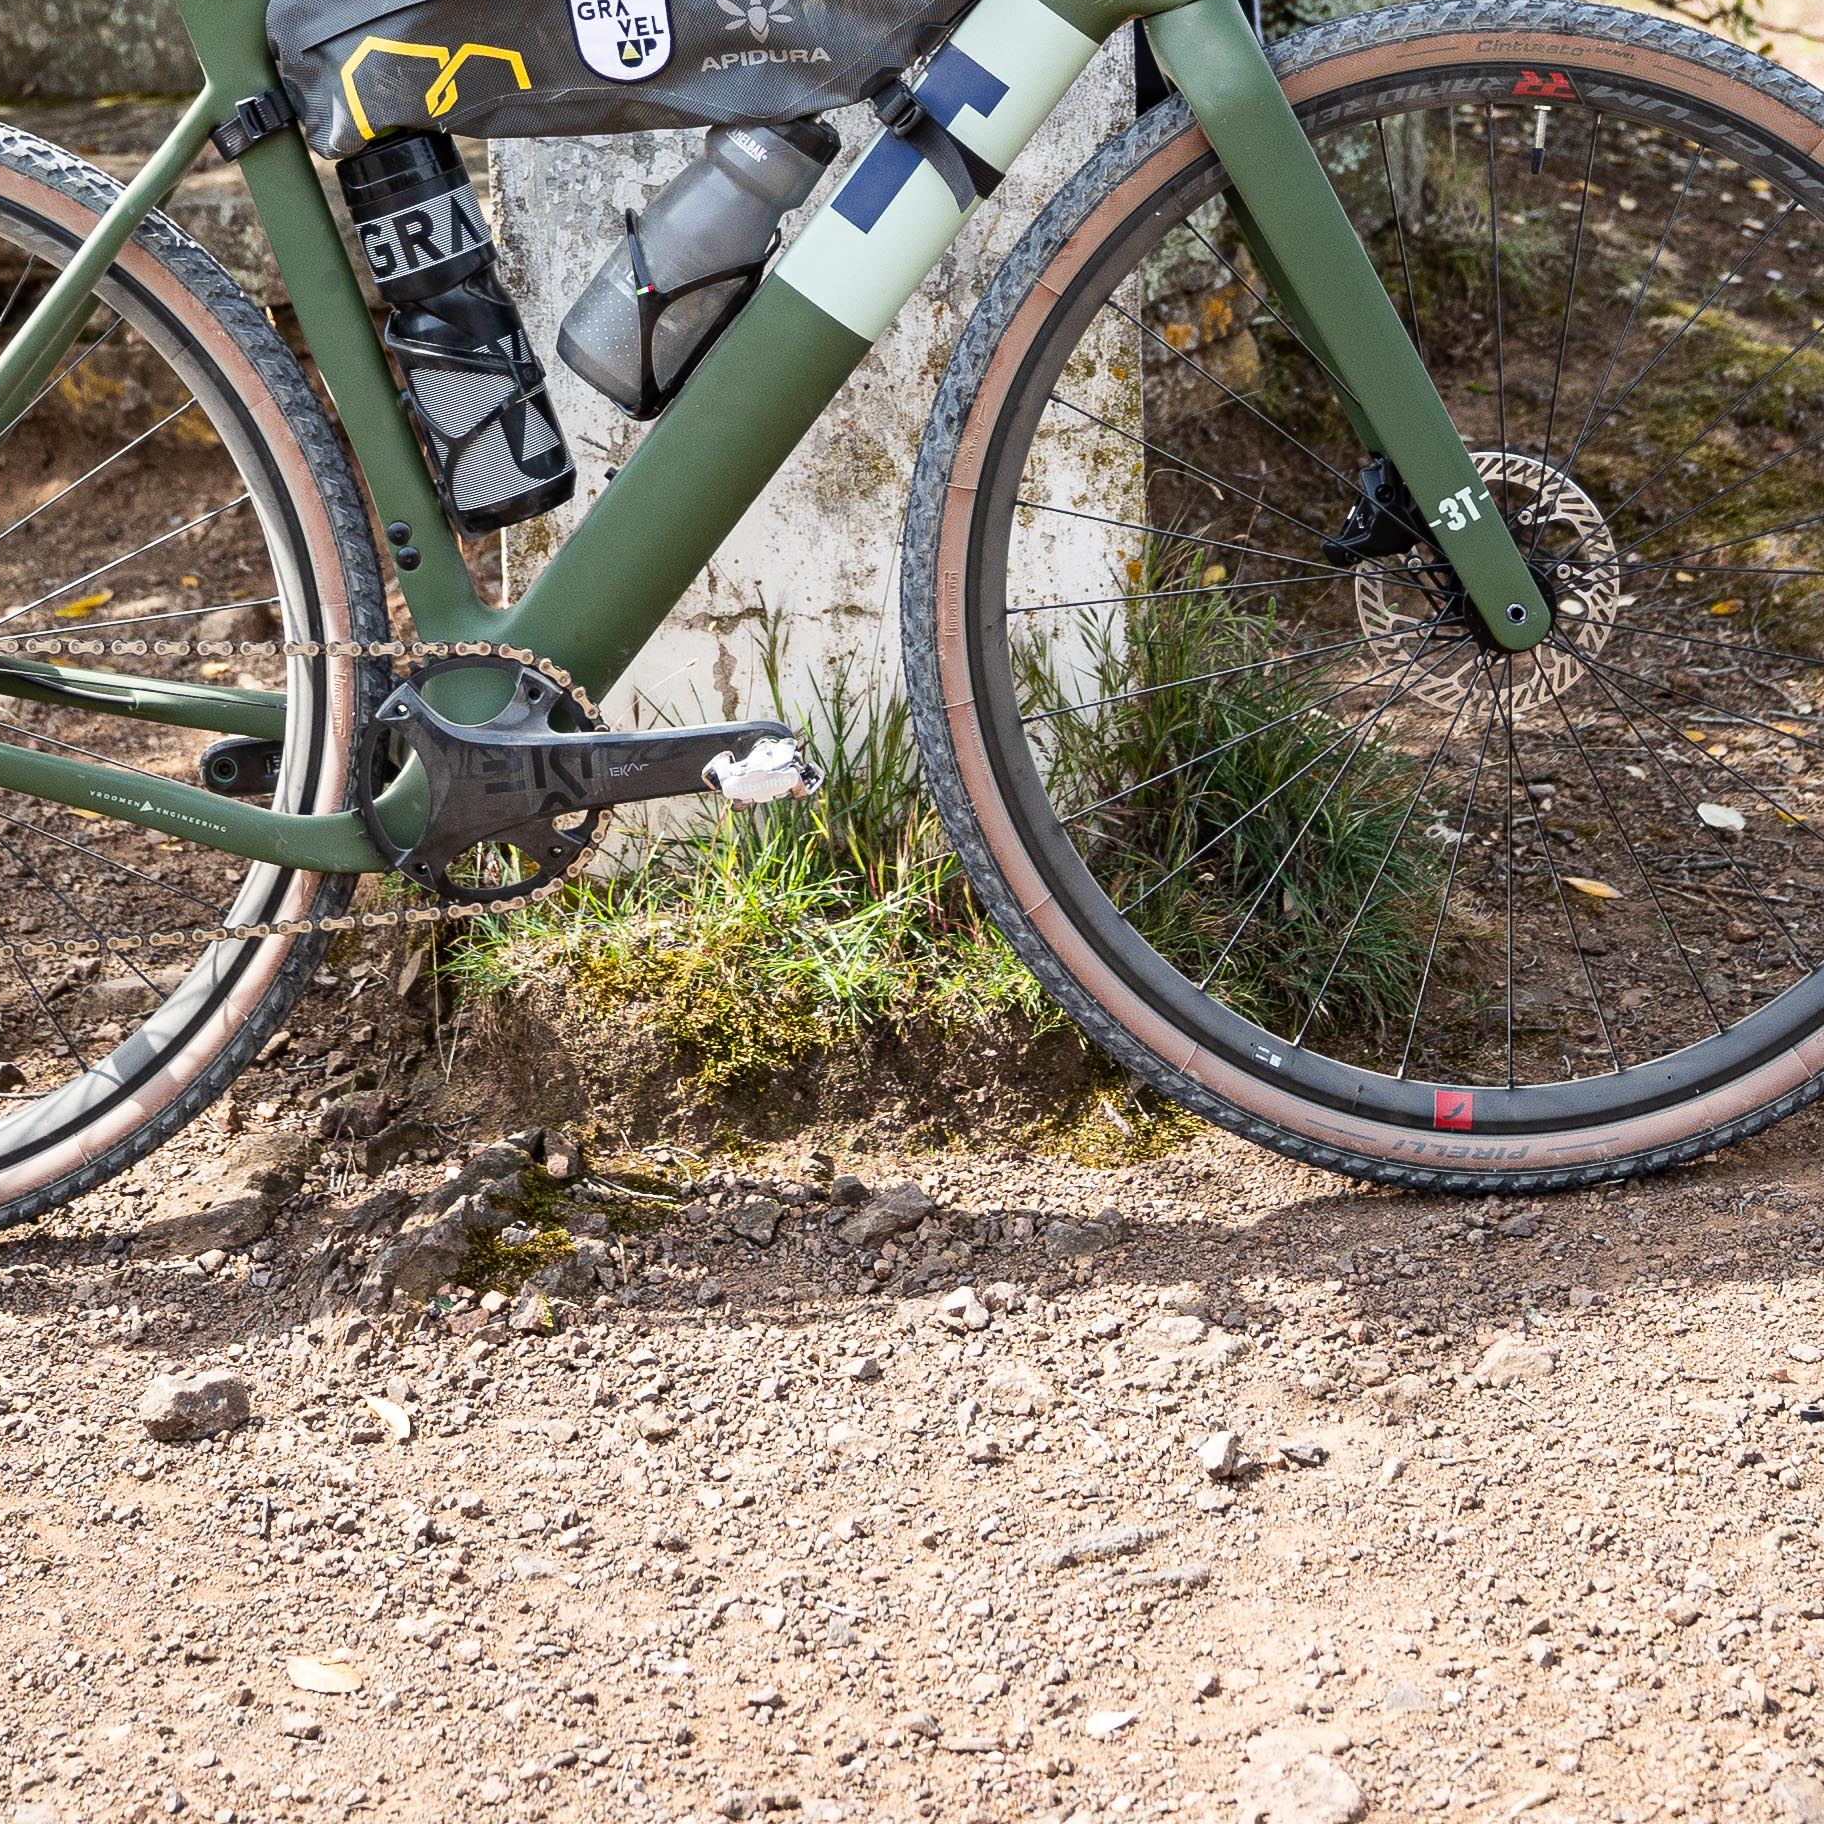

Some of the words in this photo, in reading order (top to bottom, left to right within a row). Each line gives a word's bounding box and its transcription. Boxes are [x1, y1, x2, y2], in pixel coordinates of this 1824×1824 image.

[616, 15, 665, 39] VEL
[701, 47, 832, 72] APIDURA
[726, 127, 768, 163] AMELBAK
[357, 194, 484, 271] GRA
[1438, 485, 1482, 532] 3T
[89, 789, 141, 808] VROOMEN
[155, 807, 228, 834] ENGINEERING
[1392, 1139, 1530, 1160] PIRELLI
